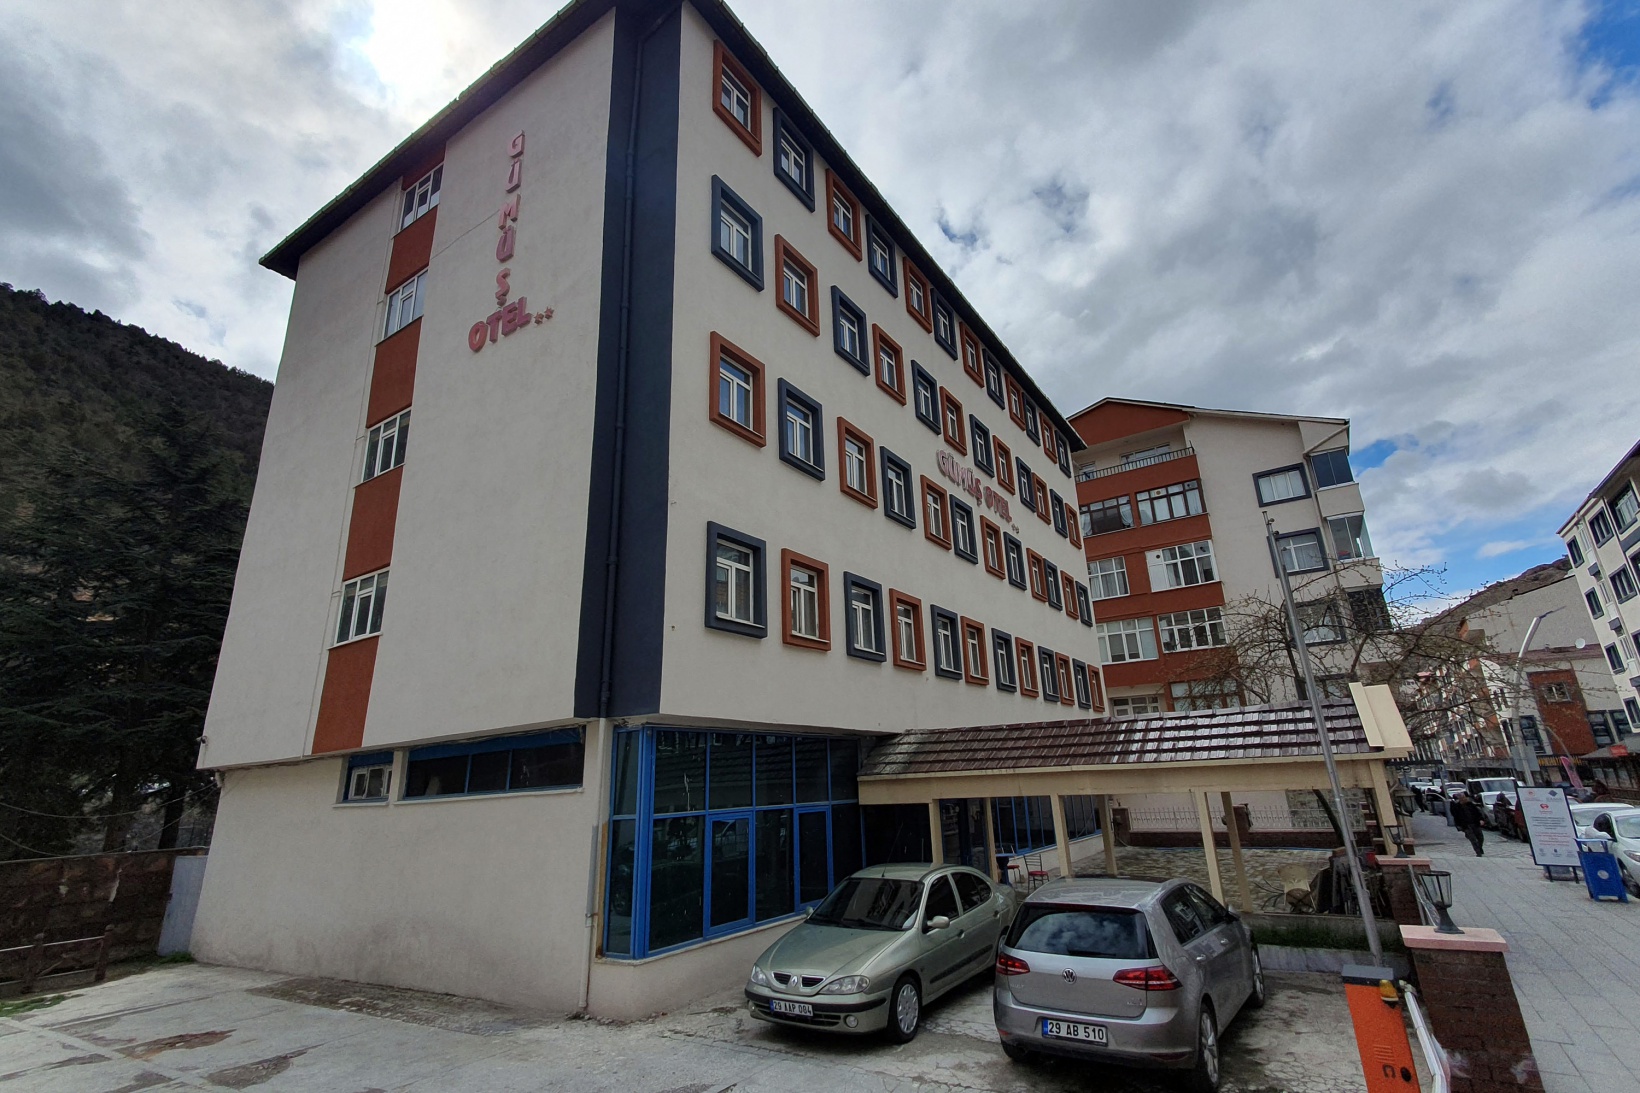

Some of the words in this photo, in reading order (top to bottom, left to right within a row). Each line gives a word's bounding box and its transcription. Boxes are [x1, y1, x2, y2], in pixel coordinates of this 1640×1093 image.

[468, 296, 532, 353] OTEL
[983, 485, 1012, 523] OTEL
[773, 1000, 782, 1010] 29
[784, 1002, 796, 1013] AAP
[798, 1004, 812, 1015] 084
[1048, 1022, 1061, 1034] 29
[1066, 1024, 1079, 1036] AB
[1084, 1026, 1104, 1040] 510
